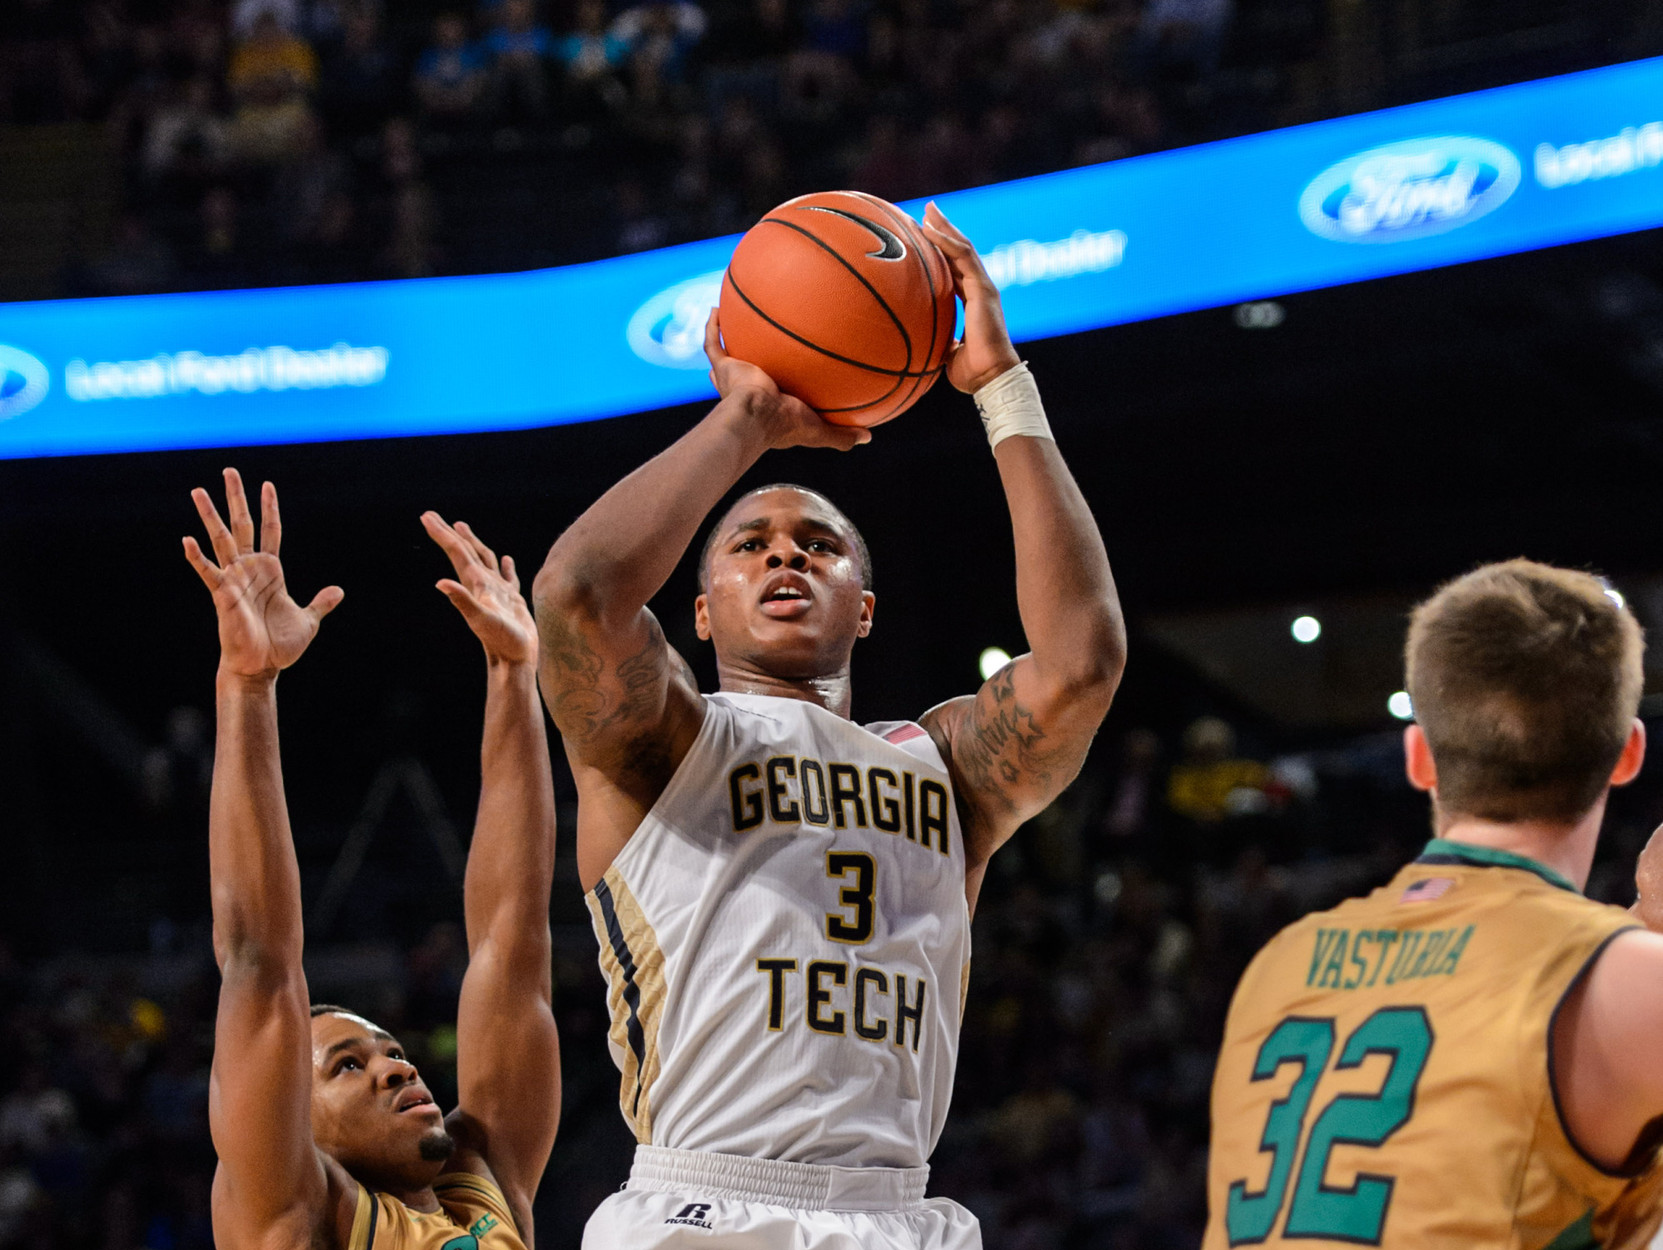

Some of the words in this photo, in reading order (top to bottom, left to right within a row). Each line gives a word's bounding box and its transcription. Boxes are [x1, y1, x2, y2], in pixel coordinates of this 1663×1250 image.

[1337, 153, 1480, 234] Ford
[728, 755, 951, 857] GEORGIA
[826, 851, 876, 945] 3
[757, 957, 926, 1053] TECH
[1225, 1004, 1435, 1250] 32
[664, 1218, 713, 1230] RUSSELL
